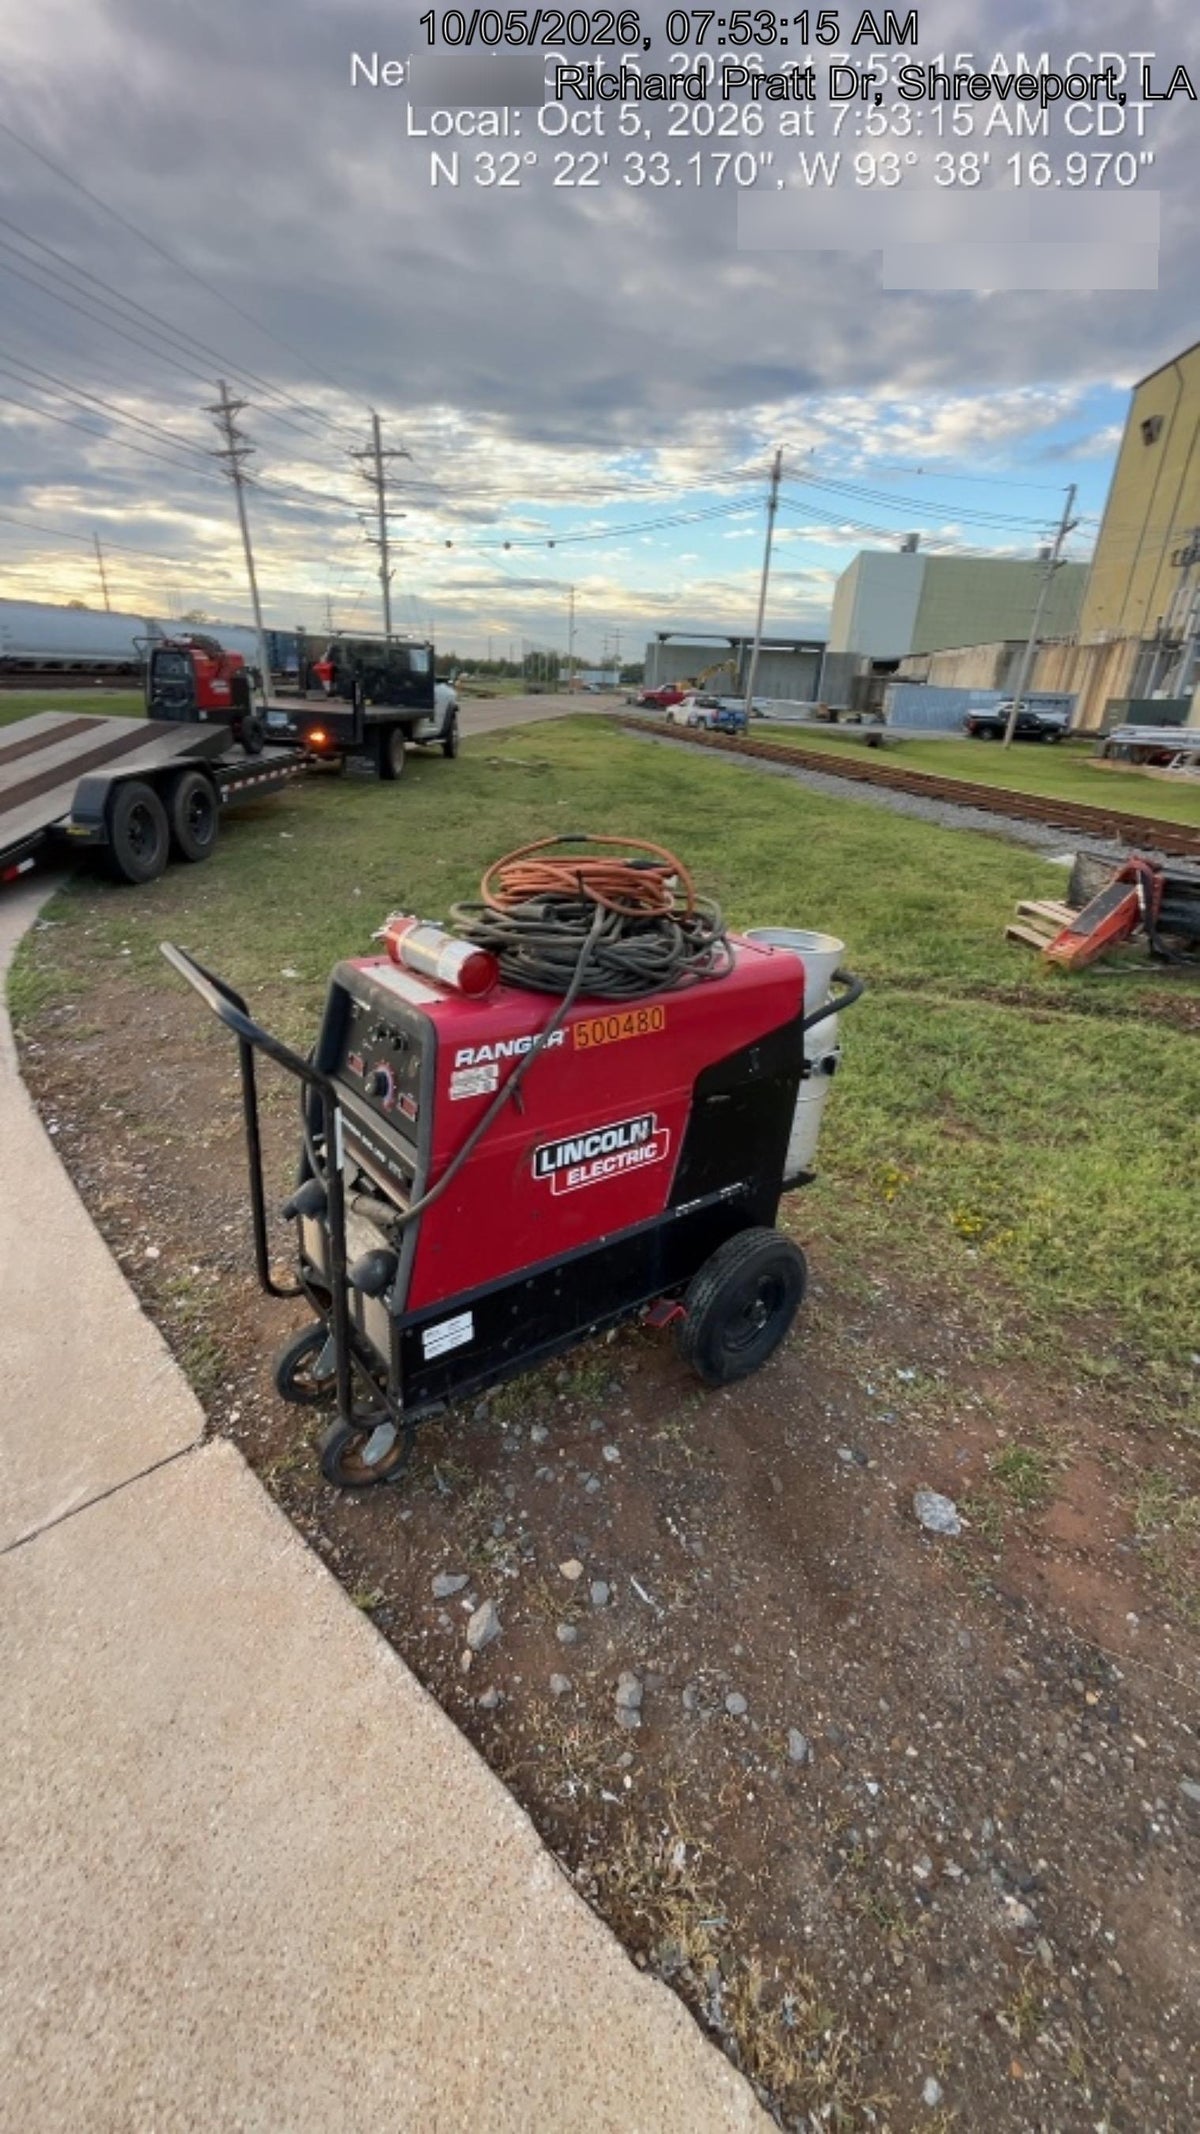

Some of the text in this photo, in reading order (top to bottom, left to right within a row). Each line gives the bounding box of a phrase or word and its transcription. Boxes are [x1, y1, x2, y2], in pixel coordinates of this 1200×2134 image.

[576, 1006, 664, 1047] 500480
[541, 1119, 651, 1173] LINCOLN
[566, 1142, 658, 1186] ELECTRIC
